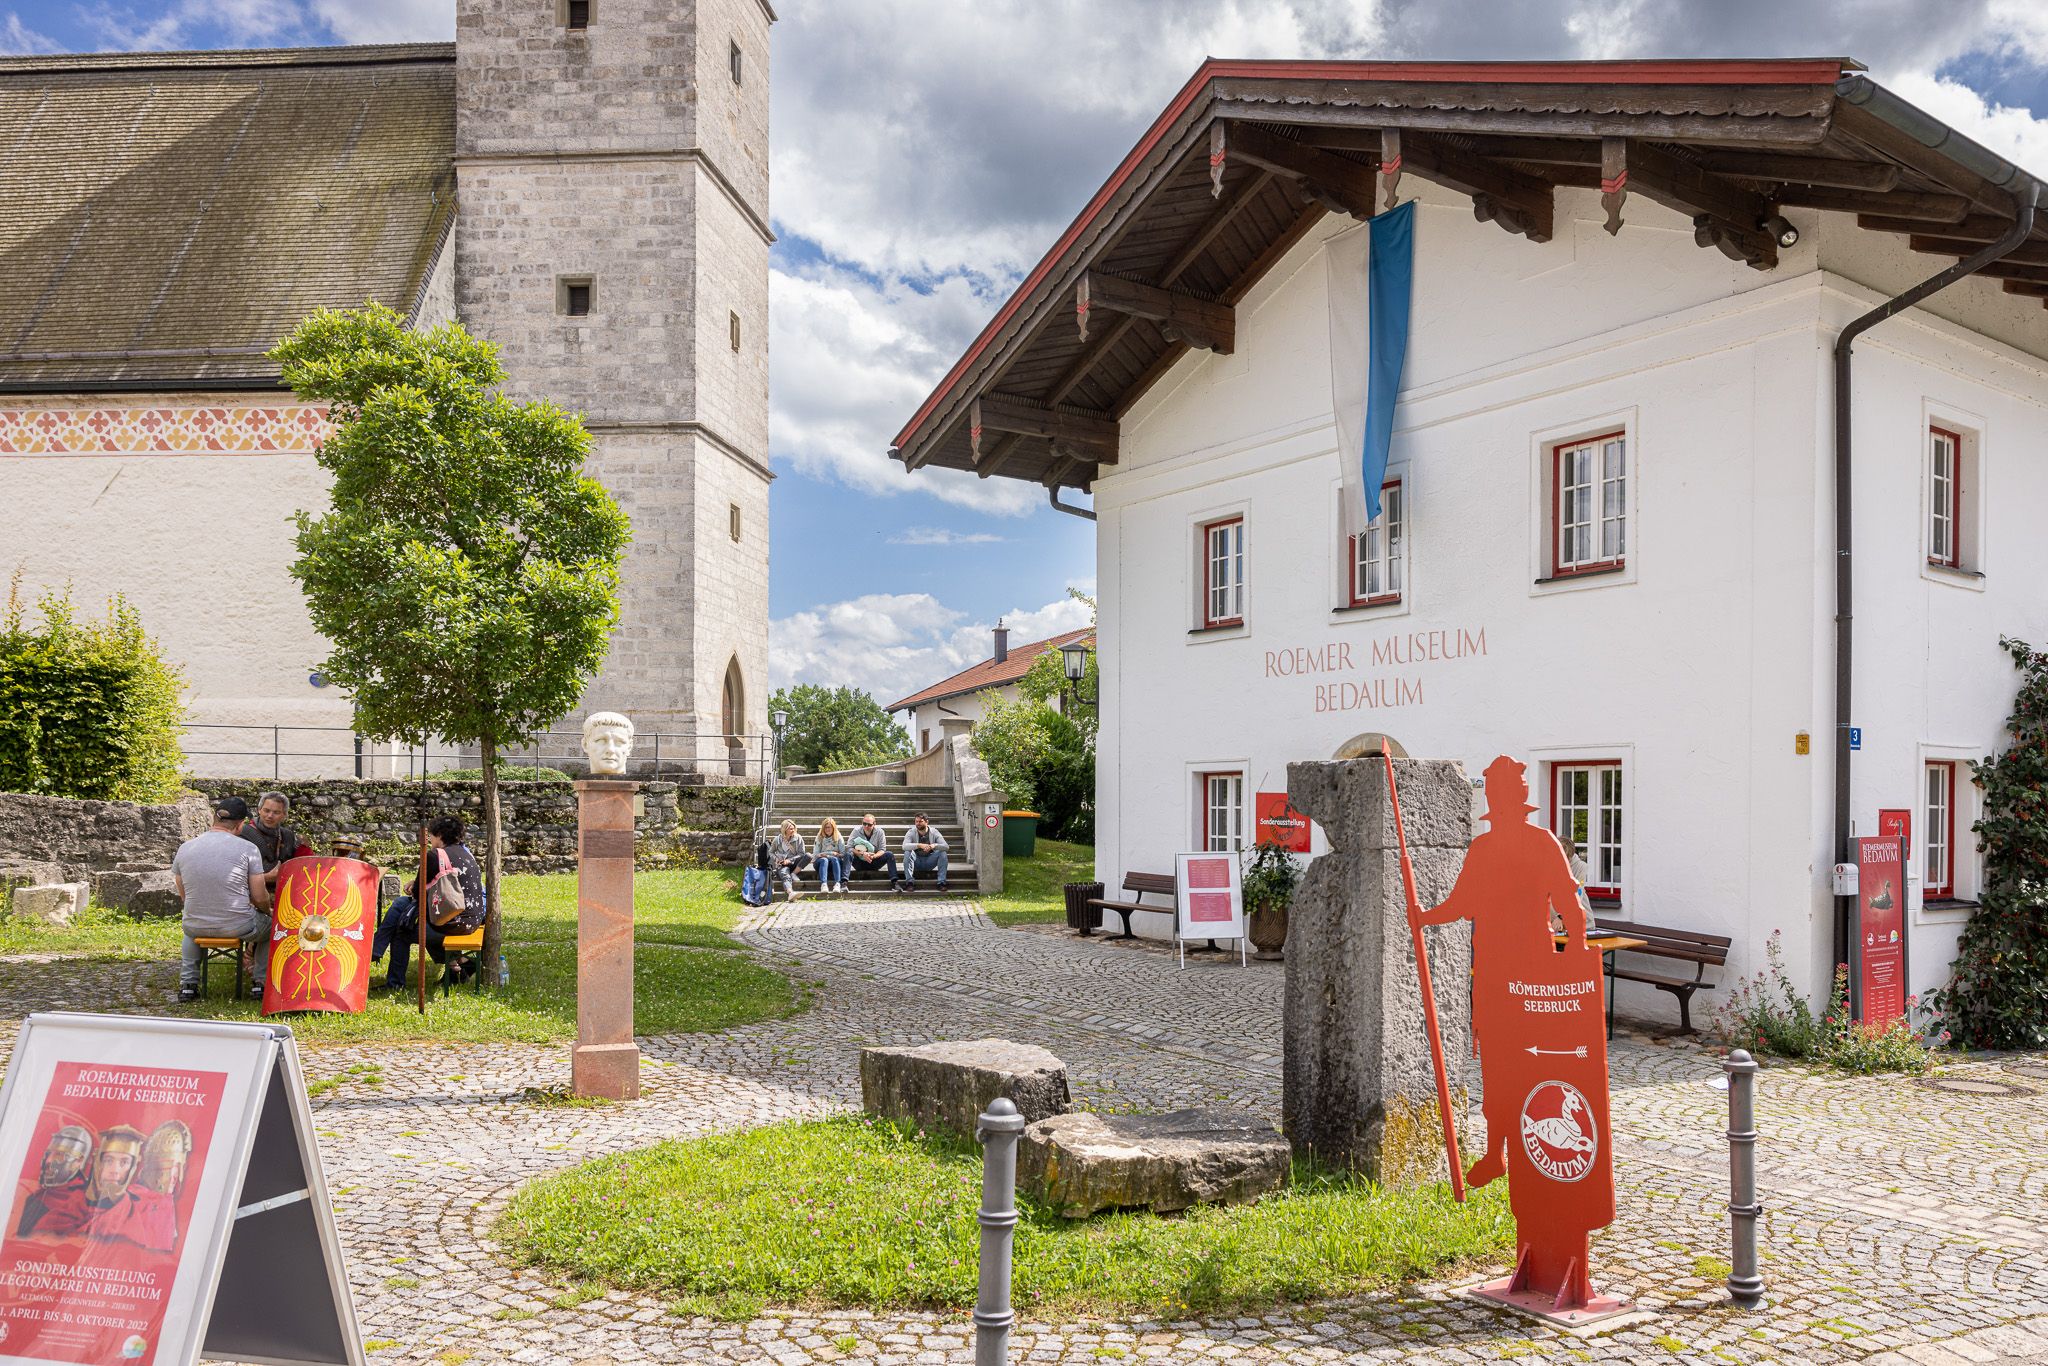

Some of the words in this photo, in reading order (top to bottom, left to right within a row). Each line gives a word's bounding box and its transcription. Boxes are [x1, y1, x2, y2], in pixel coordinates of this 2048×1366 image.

[1265, 642, 1355, 677] ROEMER
[1372, 626, 1488, 667] MUSEUM
[1315, 677, 1423, 712] BEDAIUM
[1852, 729, 1859, 742] 3
[1863, 849, 1898, 864] BEDAIVM
[1508, 980, 1595, 997] RÖMERMUSEUM
[1524, 999, 1581, 1013] SEEBRUCK
[77, 1069, 199, 1090] ROEMERMUSEUM
[63, 1084, 131, 1101] BEDAIUM
[134, 1088, 206, 1106] SEEBRUCK
[1526, 1133, 1588, 1177] BEDAIVM
[14, 1260, 156, 1284] SONDERAUSSTELLUNG
[0, 1273, 83, 1292] LEGIONAERE
[86, 1281, 101, 1295] IN
[103, 1284, 162, 1300] BEDAIUM
[9, 1308, 41, 1320] APRIL
[43, 1312, 59, 1322] BIS
[60, 1313, 74, 1324] 30.
[76, 1314, 125, 1329] OKTOBER
[126, 1319, 149, 1331] 2022
